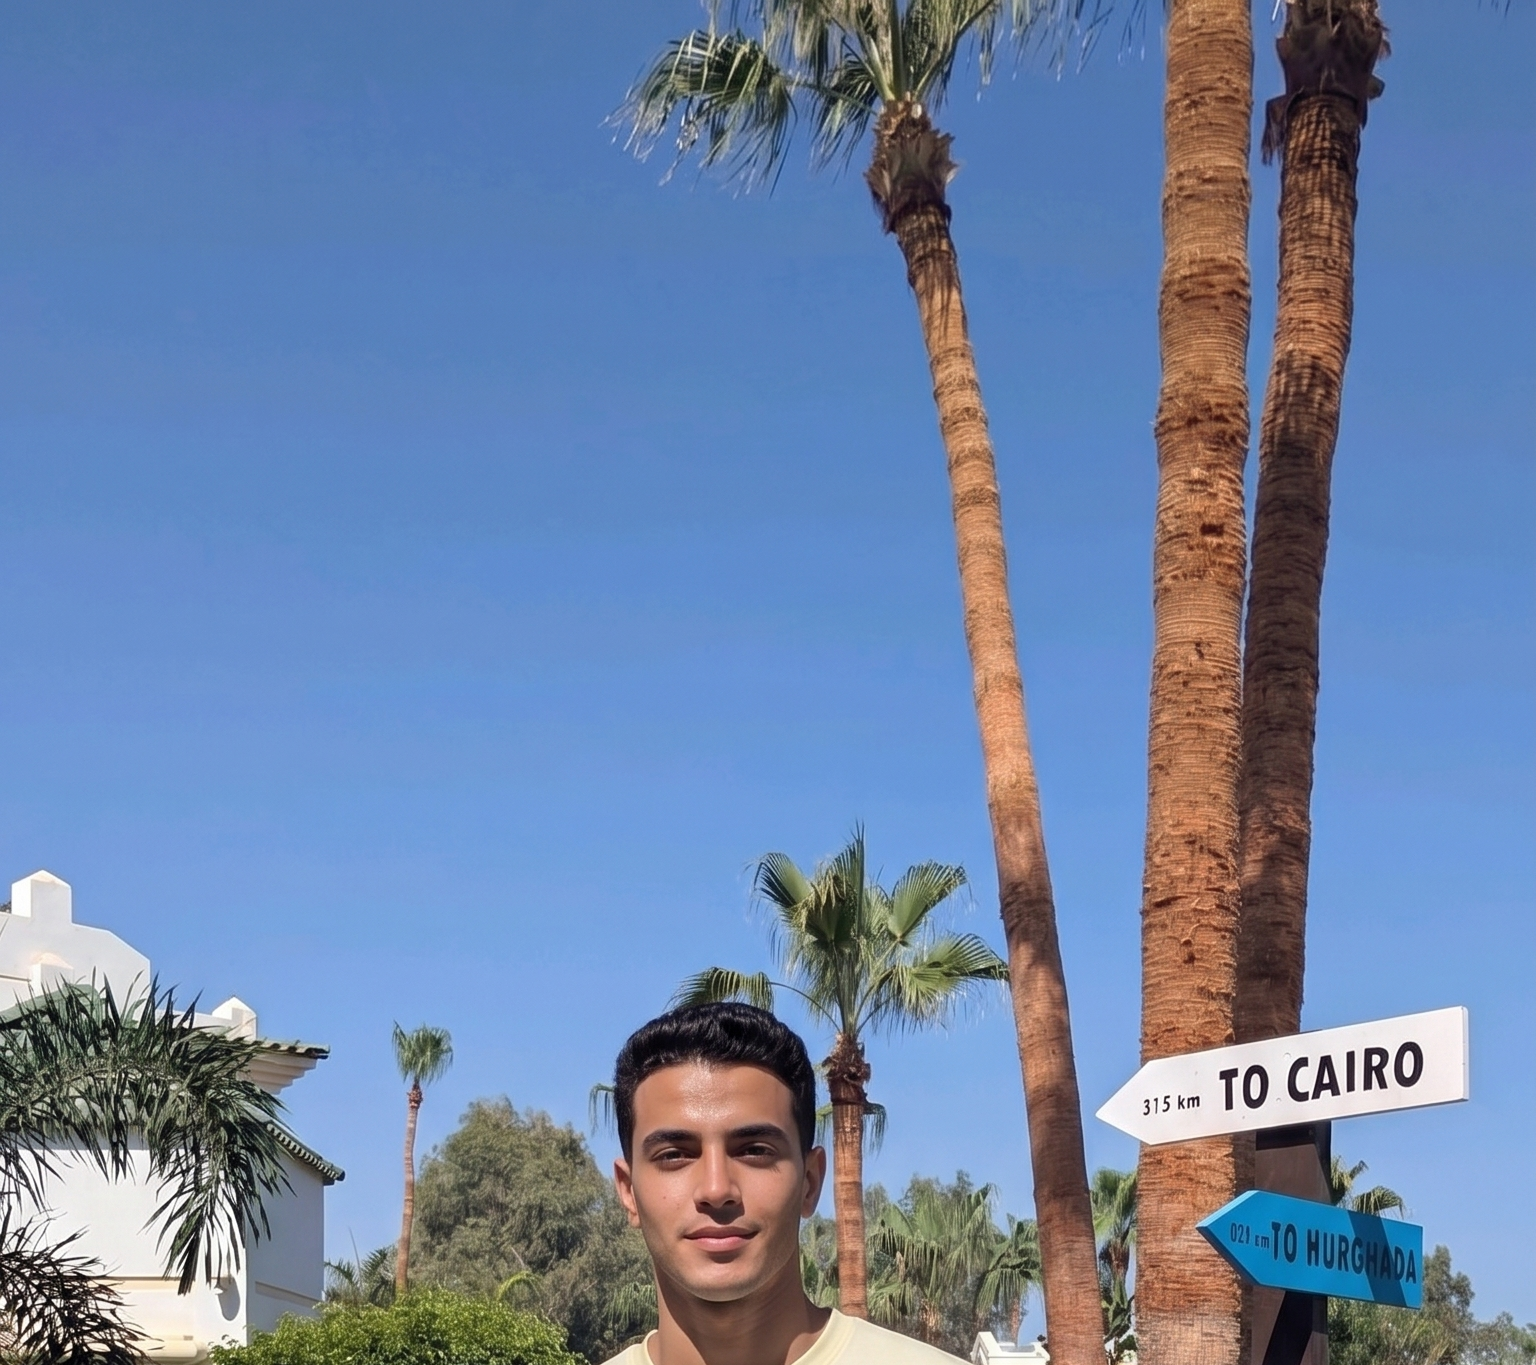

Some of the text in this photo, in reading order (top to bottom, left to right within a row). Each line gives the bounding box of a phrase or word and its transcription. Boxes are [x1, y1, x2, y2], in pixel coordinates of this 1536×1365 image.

[1142, 1041, 1424, 1116] 315 km TO CAIRO
[1271, 1221, 1298, 1263] TO
[1306, 1228, 1417, 1284] HURGHADA
